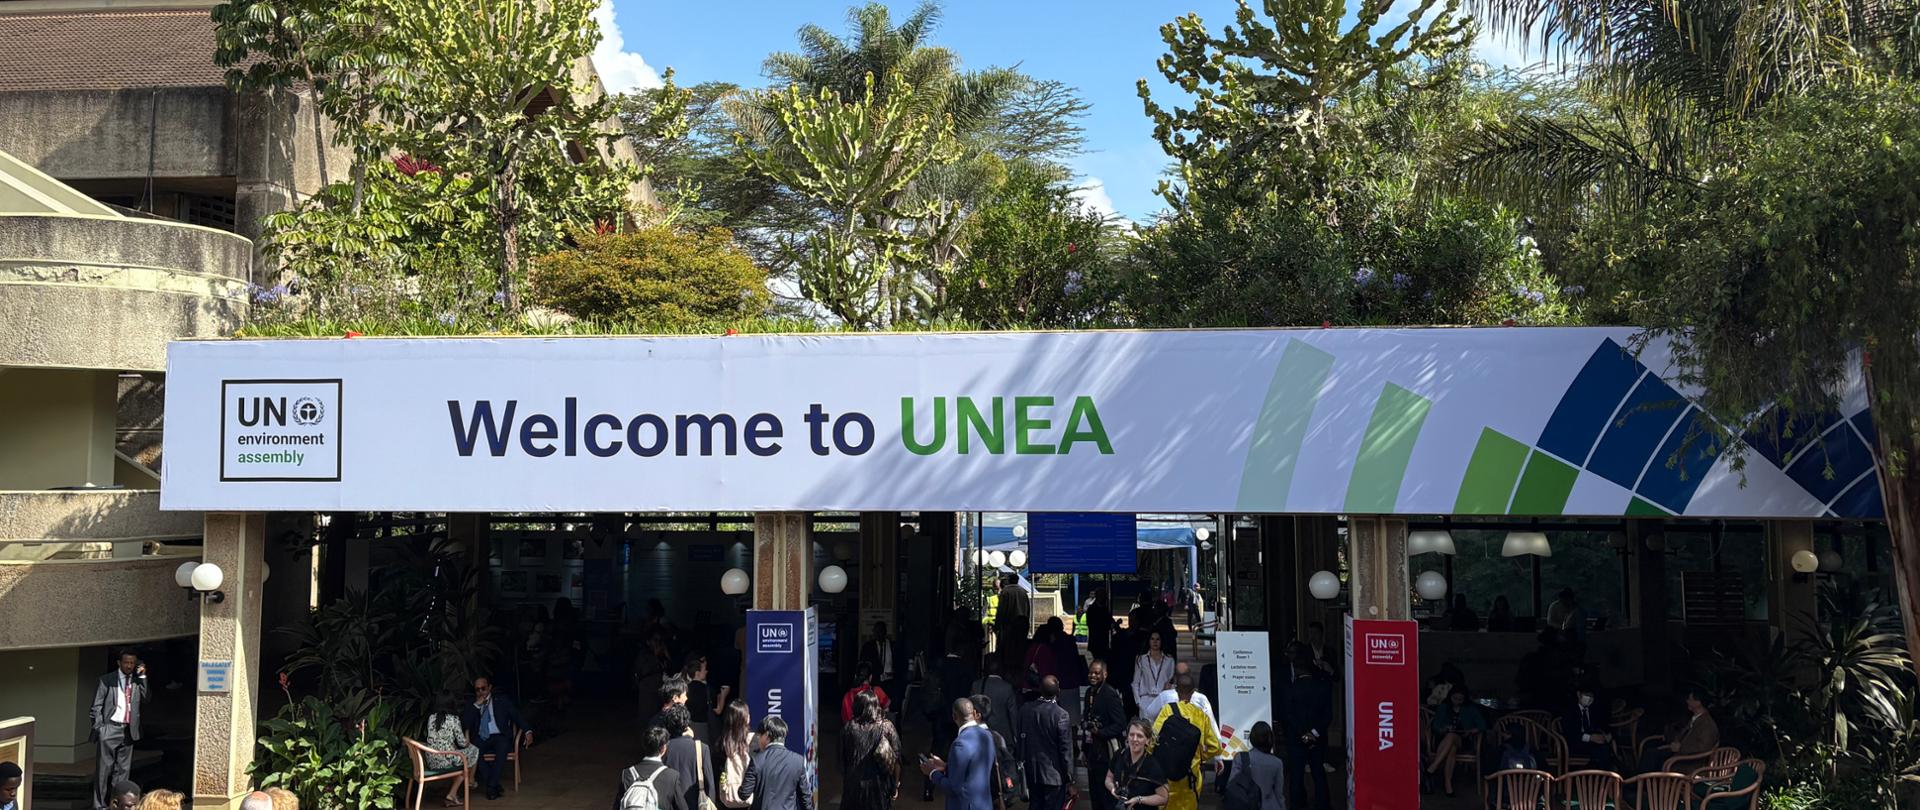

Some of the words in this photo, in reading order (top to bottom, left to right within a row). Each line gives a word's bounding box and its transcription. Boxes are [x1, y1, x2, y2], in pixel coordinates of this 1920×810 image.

[238, 397, 287, 427] UN
[448, 397, 784, 457] Welcome
[804, 403, 875, 457] to
[902, 396, 1116, 457] UNEA
[237, 432, 325, 445] environment
[238, 450, 304, 466] assembly
[762, 628, 777, 638] UN
[1371, 639, 1387, 649] UN
[1378, 701, 1395, 752] UNEA
